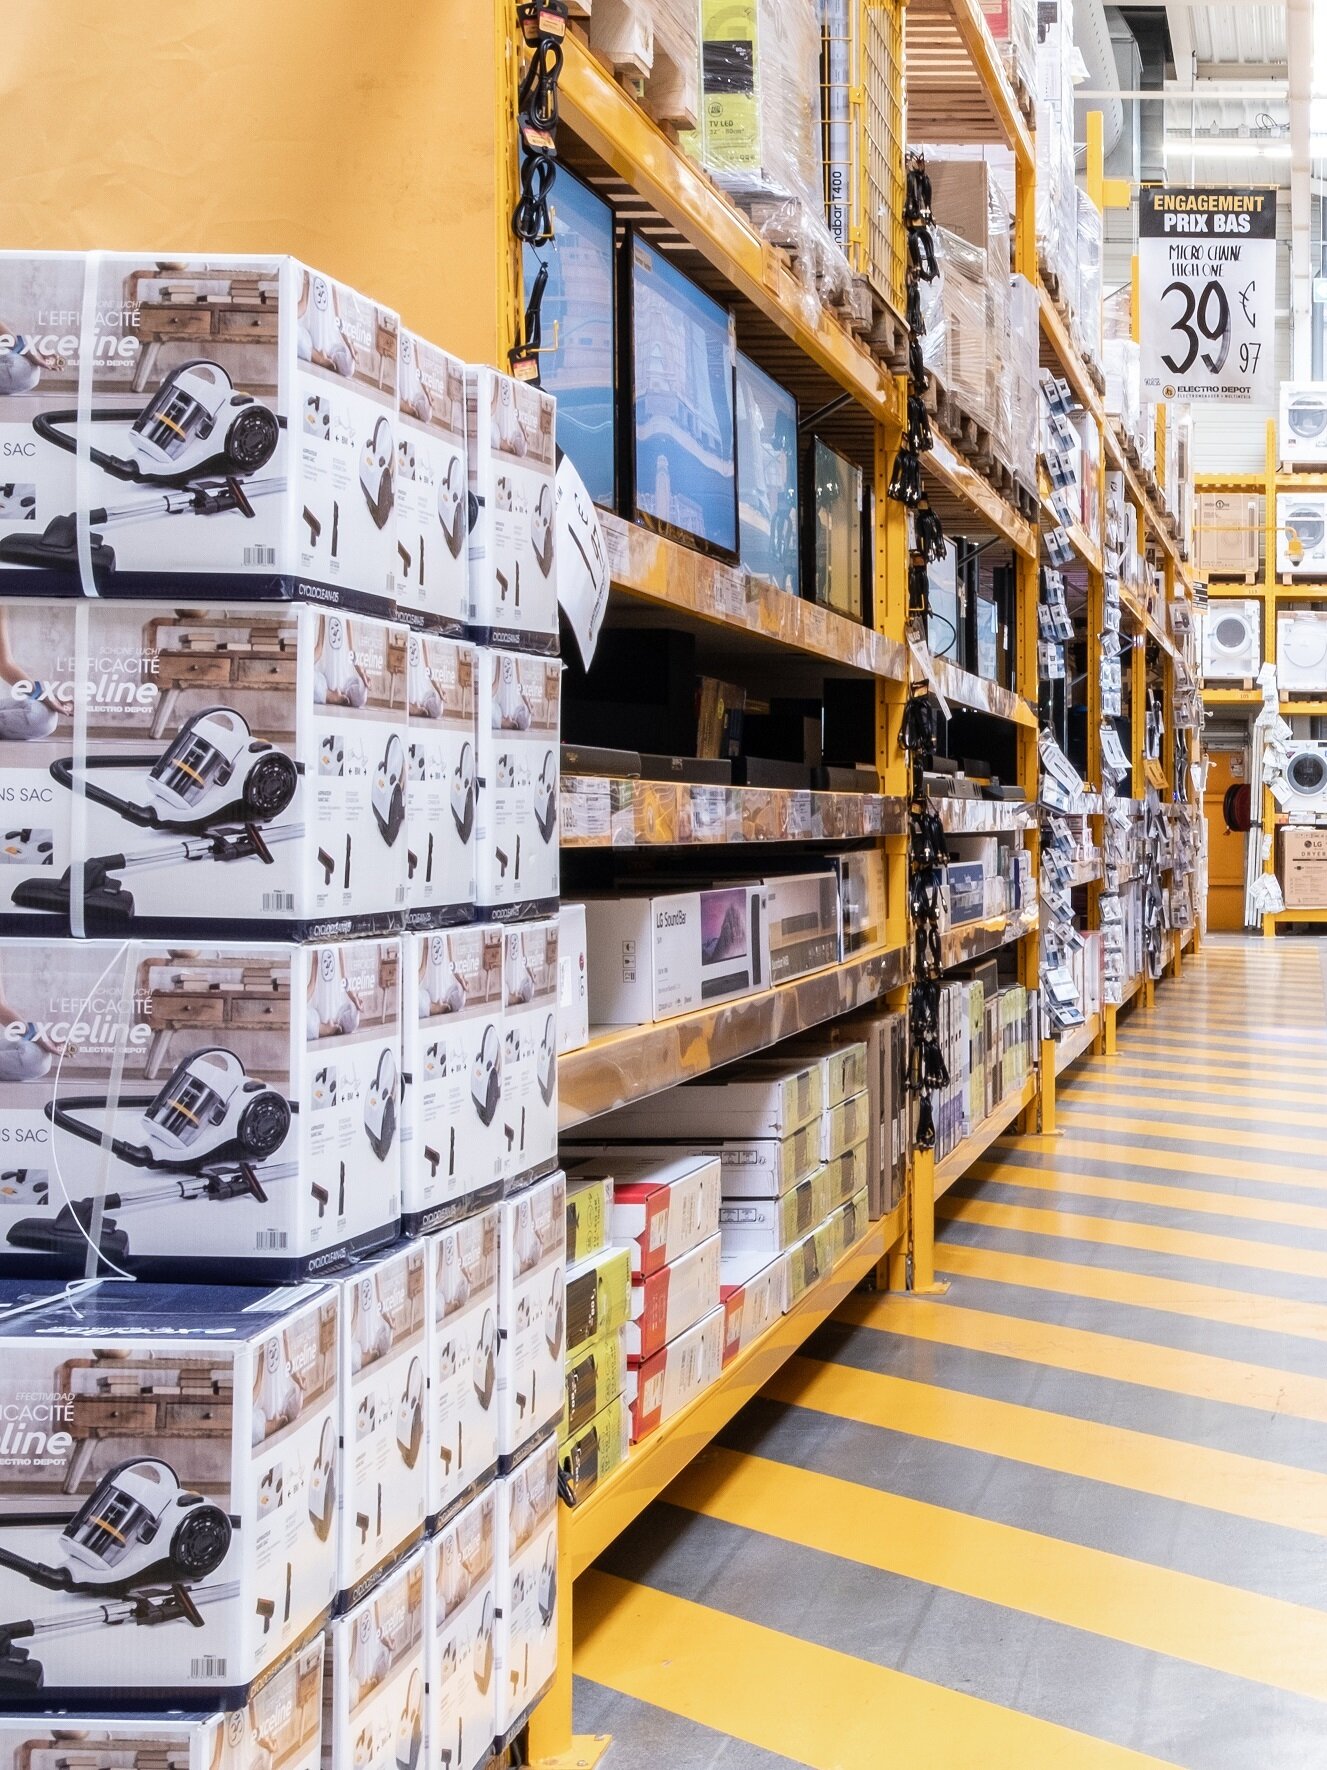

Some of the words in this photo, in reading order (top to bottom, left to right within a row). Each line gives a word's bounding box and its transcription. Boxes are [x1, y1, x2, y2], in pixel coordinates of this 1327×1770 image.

[833, 171, 842, 202] T400
[1154, 195, 1264, 211] ENGAGEMENT
[1164, 213, 1208, 232] PRIX
[1214, 214, 1250, 233] BAS
[1169, 245, 1204, 260] MICRO
[1172, 263, 1199, 276] HIGH
[1202, 263, 1224, 277] ONE
[38, 308, 141, 327] L'EFFIACITÉ
[1161, 280, 1231, 374] 39
[1238, 281, 1255, 328] €
[0, 328, 140, 357] exceine
[1240, 343, 1261, 374] 97
[3, 442, 36, 456] SAC
[299, 584, 339, 602] CYCLOCLEAN-05
[56, 656, 159, 674] L'EFICACITÉ
[350, 651, 383, 669] exceline
[20, 788, 53, 801] SAC
[657, 912, 663, 928] LG
[665, 910, 686, 926] SoundBar
[4, 1015, 151, 1043] exceline
[15, 1129, 48, 1143] SAC
[252, 1700, 292, 1741] exceline
